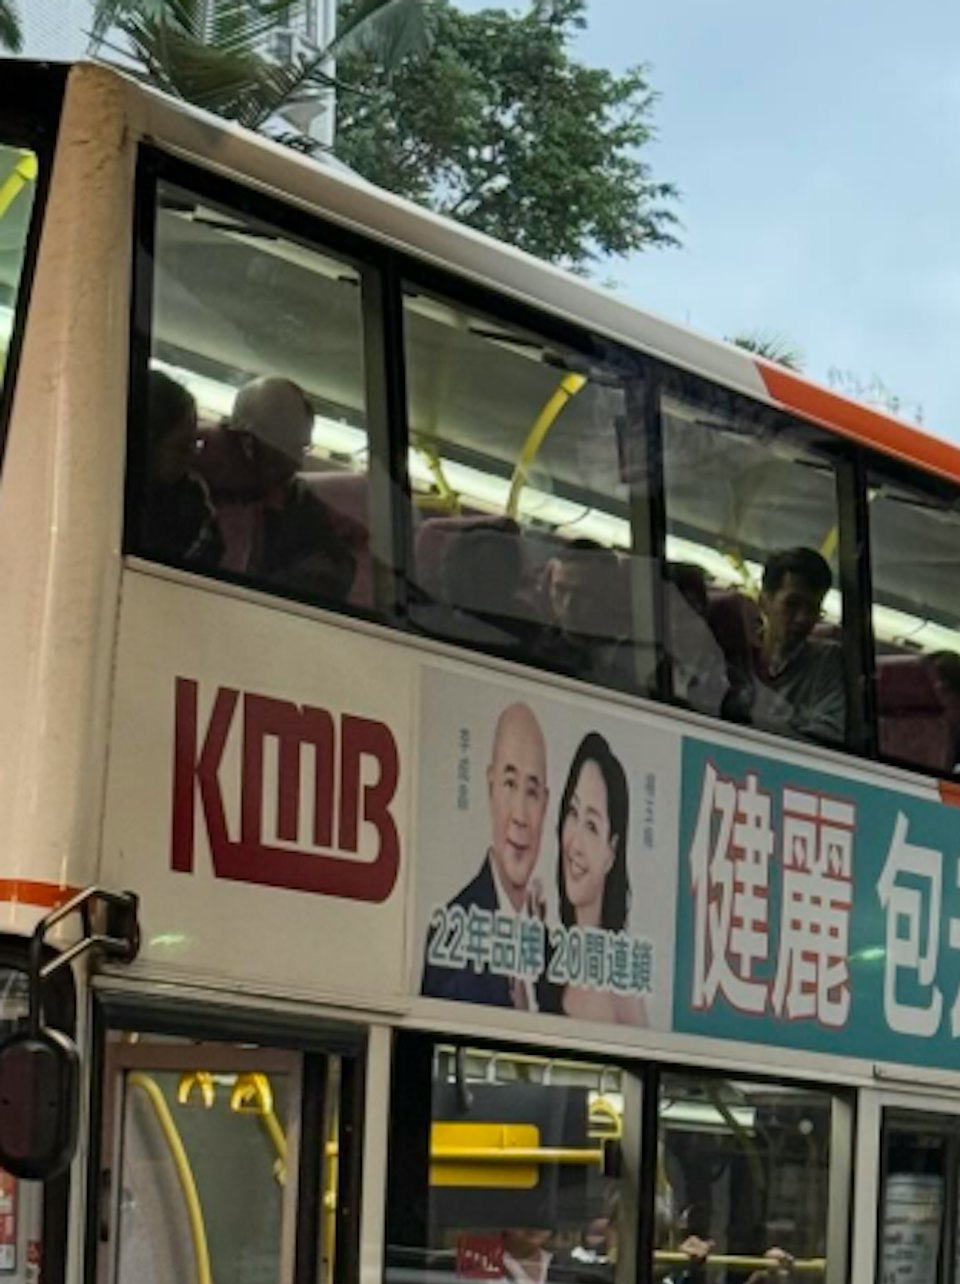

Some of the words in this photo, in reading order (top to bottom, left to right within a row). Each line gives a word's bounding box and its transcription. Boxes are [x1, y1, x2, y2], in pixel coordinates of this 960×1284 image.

[170, 676, 402, 903] KMB
[687, 759, 856, 1028] 健麗
[429, 907, 545, 974] 22年品牌
[549, 929, 654, 994] 20間連鎖
